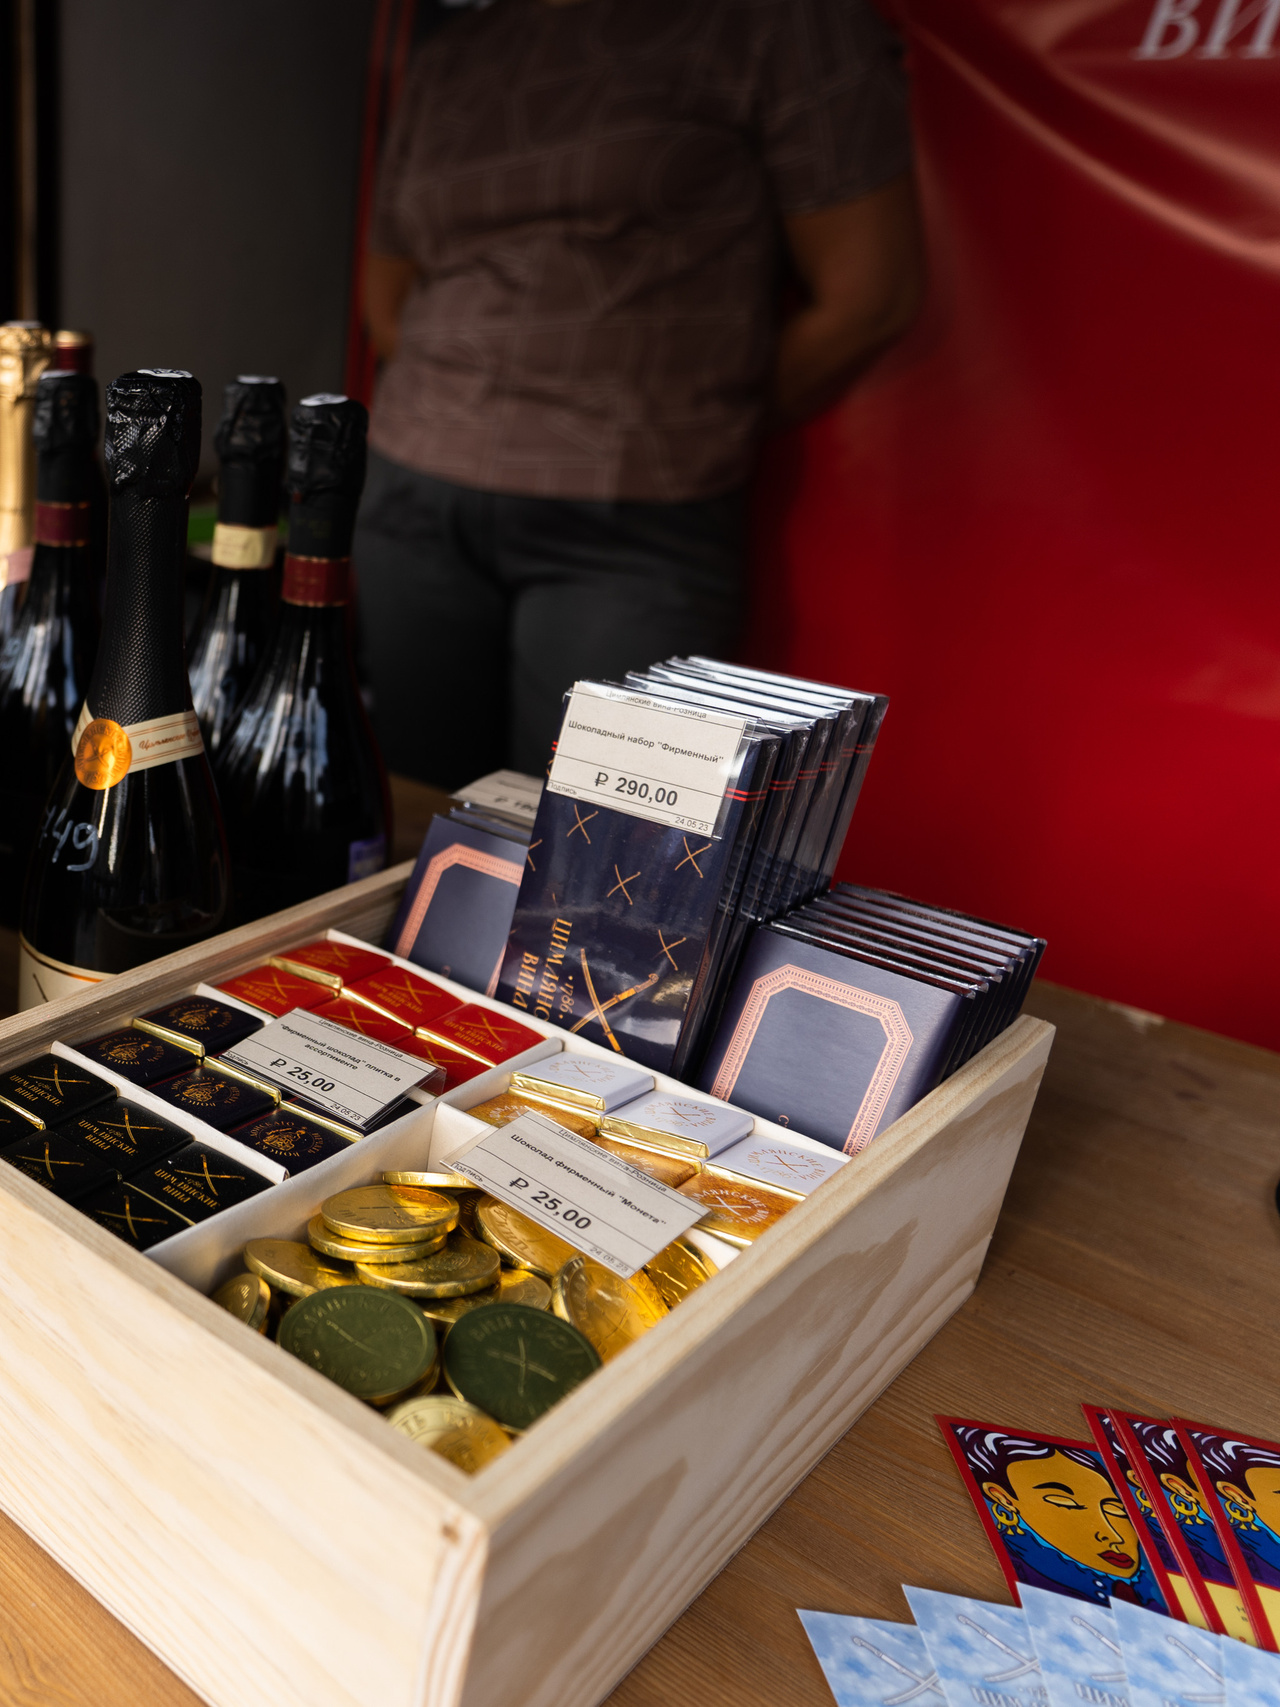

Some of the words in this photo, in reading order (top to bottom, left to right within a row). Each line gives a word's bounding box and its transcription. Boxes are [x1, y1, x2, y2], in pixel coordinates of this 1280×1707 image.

[568, 720, 625, 741] Шоколадный
[627, 734, 655, 749] набор
[657, 741, 724, 764] "Фирменный"
[615, 777, 678, 806] 290,00
[675, 816, 709, 832] 24.05.23
[560, 982, 575, 1014] 1786
[304, 1043, 358, 1070] ассортименте
[365, 1062, 394, 1079] плитка
[287, 1066, 335, 1092] 25,00
[330, 1103, 361, 1121] 24.05.23
[559, 1129, 608, 1160] Цимлянские
[608, 1156, 667, 1192] вина-Розница
[510, 1134, 554, 1162] Шоколад
[554, 1160, 615, 1198] фирменный
[618, 1195, 667, 1225] "Монета"
[531, 1190, 592, 1230] 25,00
